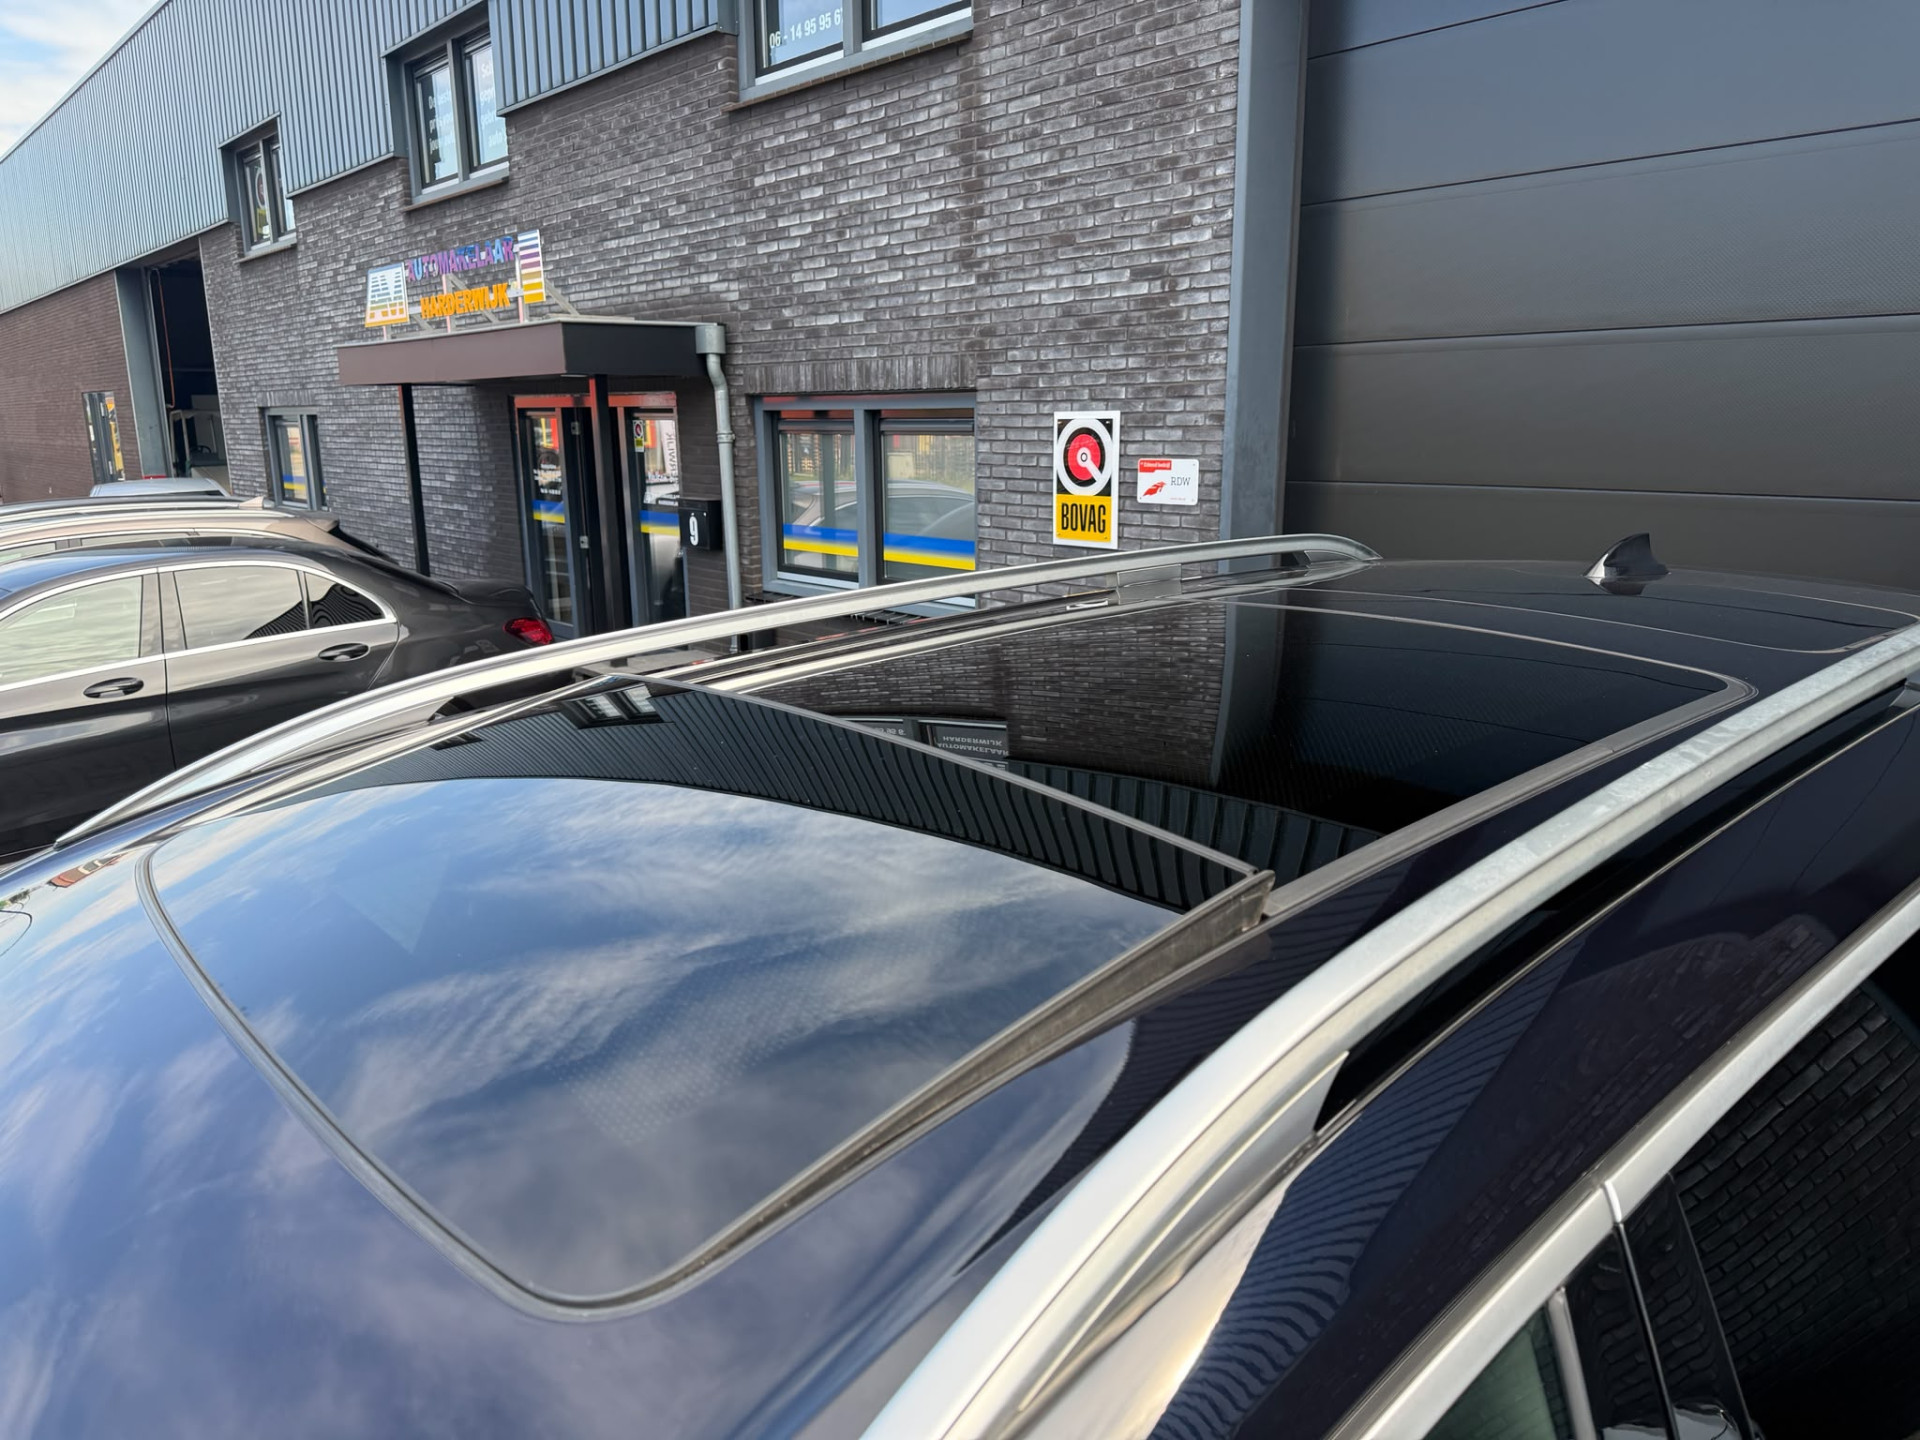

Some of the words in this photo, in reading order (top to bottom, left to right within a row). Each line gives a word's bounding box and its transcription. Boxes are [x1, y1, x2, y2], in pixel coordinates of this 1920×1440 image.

[769, 31, 781, 49] 06
[790, 24, 802, 41] 14
[804, 17, 817, 36] 95
[819, 13, 832, 31] 95
[406, 236, 514, 282] AUTOMAKELAAR
[420, 282, 511, 319] HARDERWIJK
[1170, 476, 1191, 487] RDW
[689, 516, 699, 546] 9
[1061, 503, 1106, 533] BOVAG
